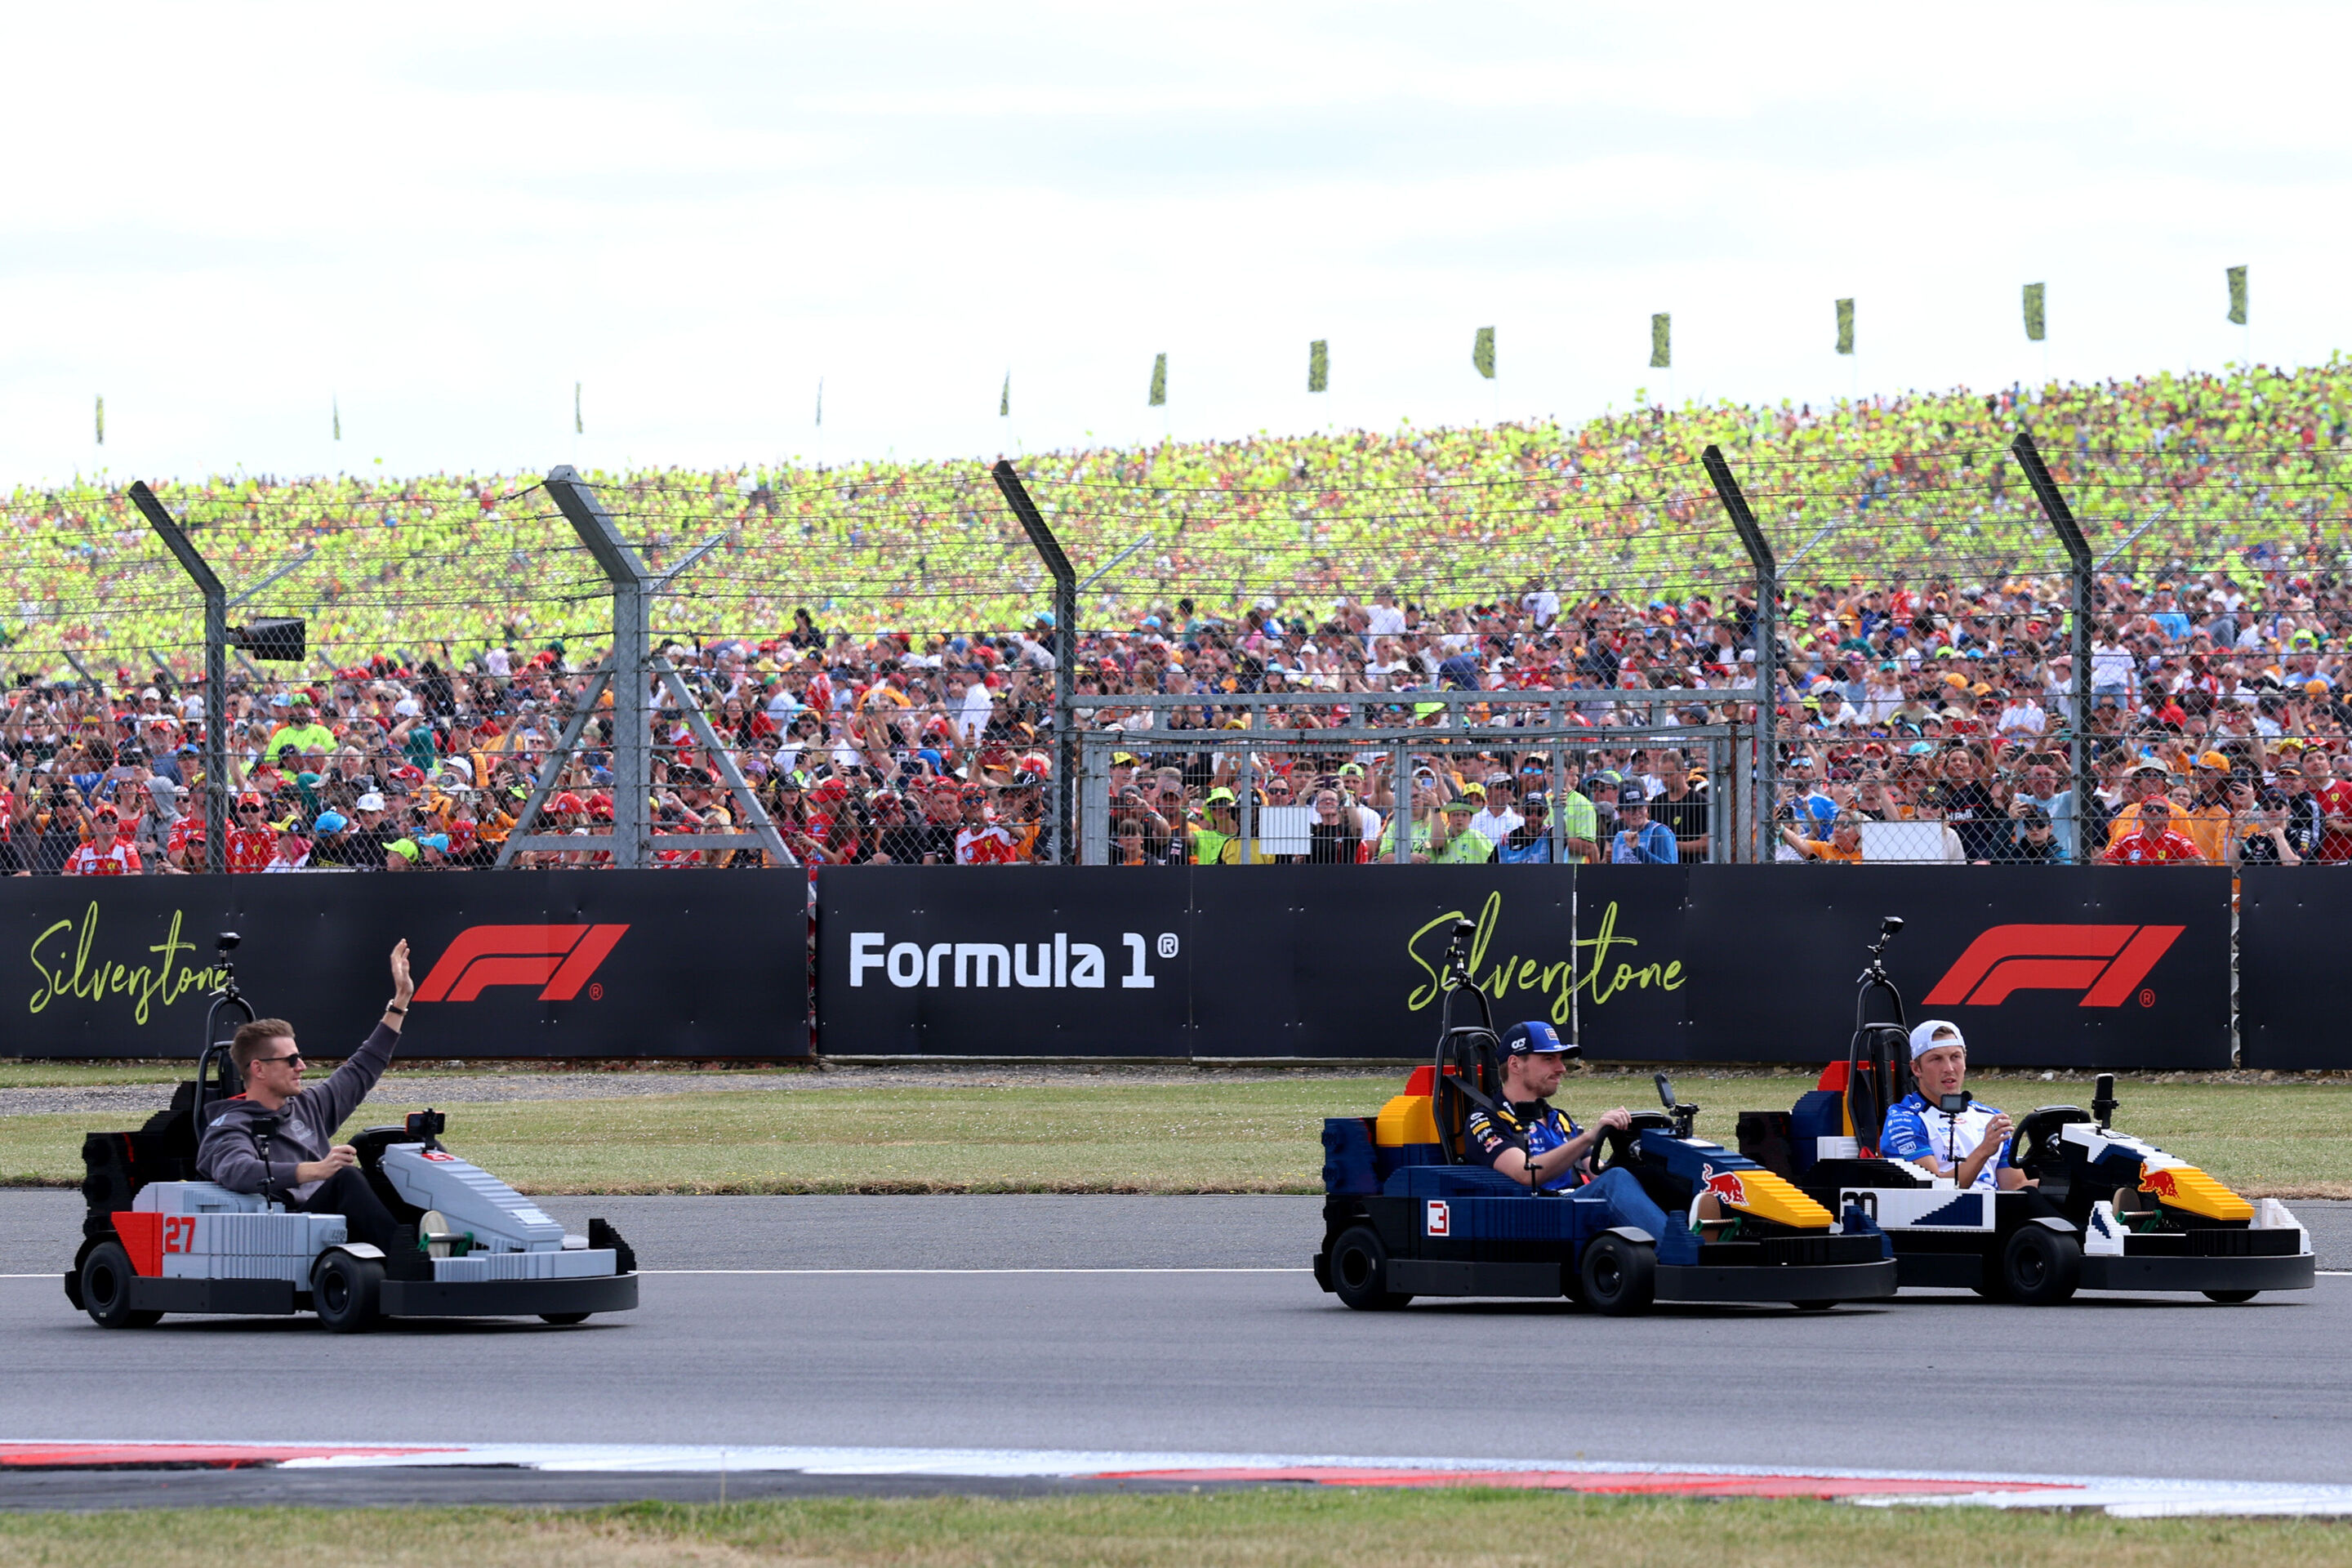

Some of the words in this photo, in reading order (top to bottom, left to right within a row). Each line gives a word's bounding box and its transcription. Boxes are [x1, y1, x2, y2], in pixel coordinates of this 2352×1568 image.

[29, 900, 230, 1025] Silverstone
[849, 932, 1105, 988] Formula
[1408, 890, 1687, 1024] Silverstone
[165, 1216, 196, 1253] 27
[1429, 1202, 1449, 1234] 3
